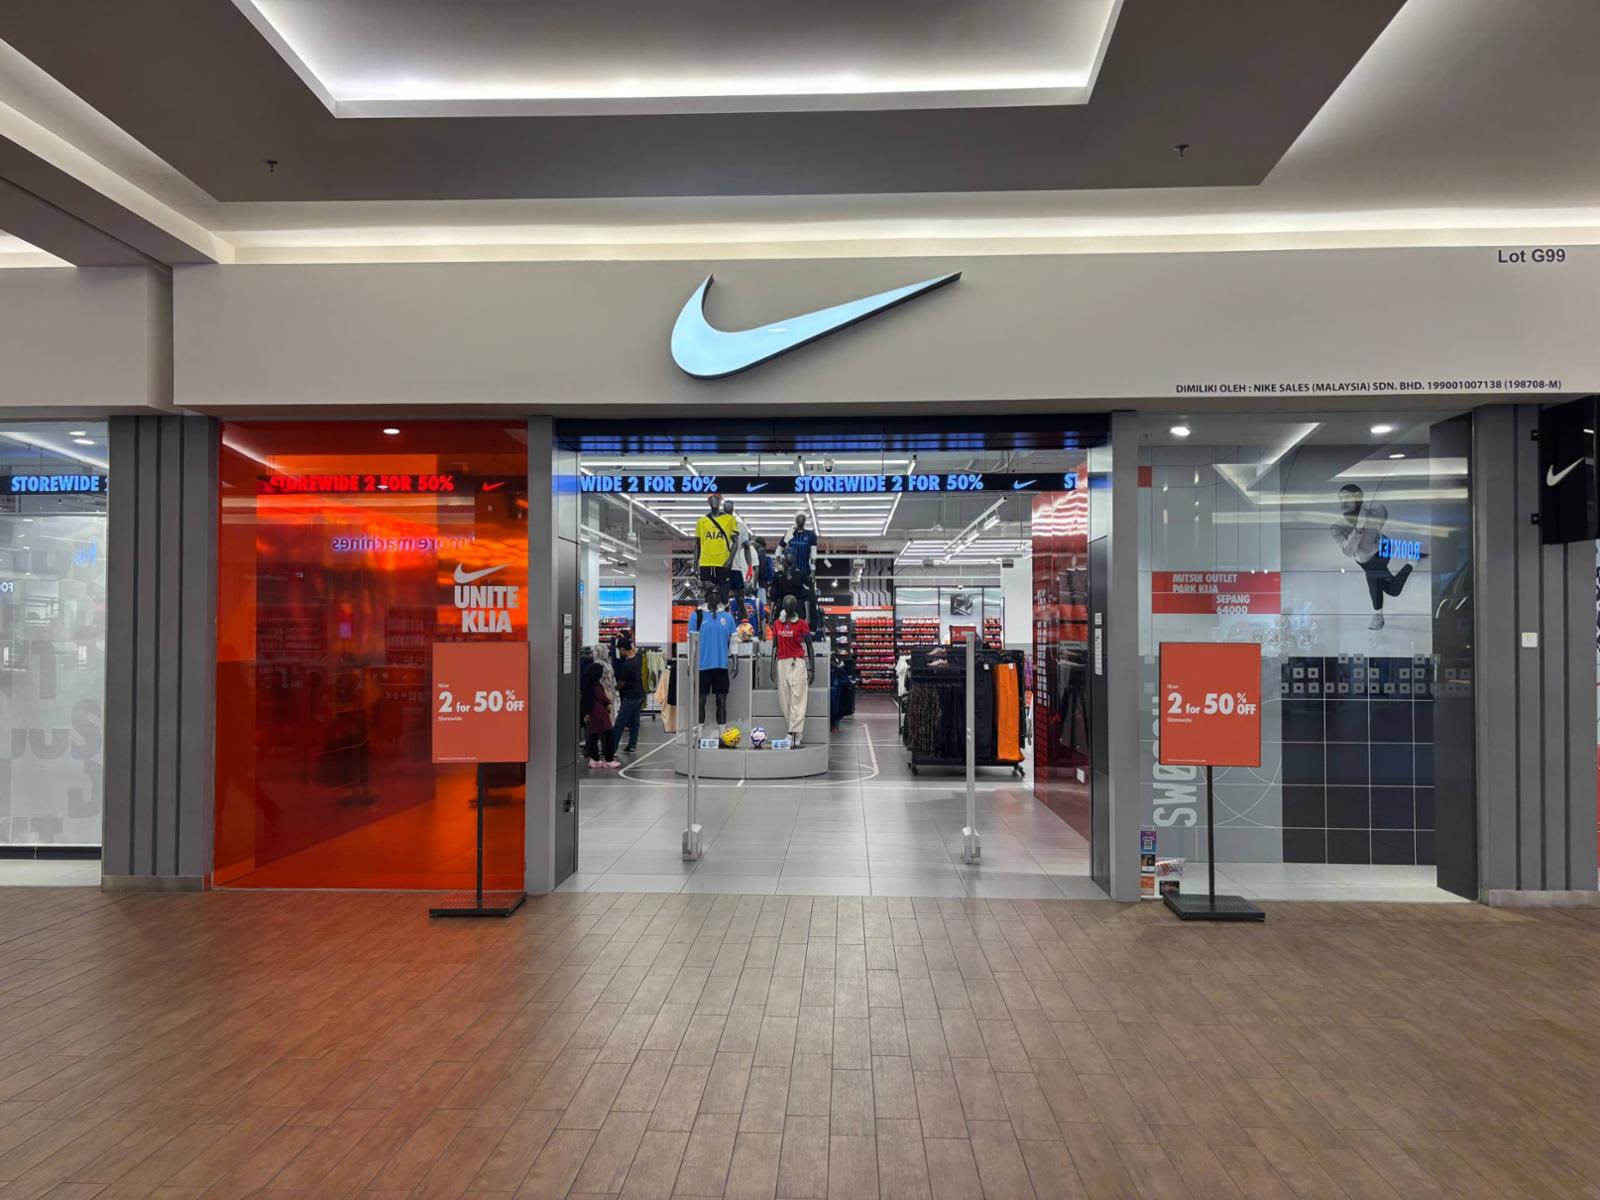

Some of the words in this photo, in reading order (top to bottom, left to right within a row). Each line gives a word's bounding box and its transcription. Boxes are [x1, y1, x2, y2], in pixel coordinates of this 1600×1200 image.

[1498, 249, 1526, 263] Lot
[1531, 248, 1566, 263] G99
[1176, 384, 1218, 393] DIMILIKI
[1219, 384, 1246, 393] OLEH
[1253, 384, 1277, 393] NIKE
[1279, 383, 1310, 392] SALES
[1311, 382, 1371, 393] (MALAYSIA)
[1372, 382, 1398, 391] SDN.
[1400, 382, 1425, 391] BHD.
[1427, 380, 1502, 390] 199001007138
[1504, 379, 1562, 391] (198708-M)
[11, 476, 100, 492] STOREWIDE
[364, 475, 376, 491] 2
[417, 475, 455, 491] 50%
[627, 475, 639, 492] 2
[644, 475, 675, 492] FOR
[682, 475, 718, 492] 50%
[795, 475, 885, 492] STOREWIDE
[892, 475, 903, 491] 2
[908, 474, 940, 490] FOR
[946, 473, 984, 490] 50%
[1172, 574, 1204, 583] MITSUI
[1205, 573, 1238, 583] OUTLET
[1172, 584, 1197, 593] PARK
[1199, 584, 1219, 593] KLIA
[454, 585, 520, 609] UNITE
[1216, 594, 1251, 604] SEPANG
[1216, 605, 1248, 614] 64000
[461, 610, 513, 633] KLIA
[438, 691, 453, 713] 2
[456, 701, 470, 713] for
[506, 701, 525, 712] OFF
[1167, 692, 1182, 714] 2
[1185, 703, 1201, 714] for
[1236, 704, 1257, 715] OFF
